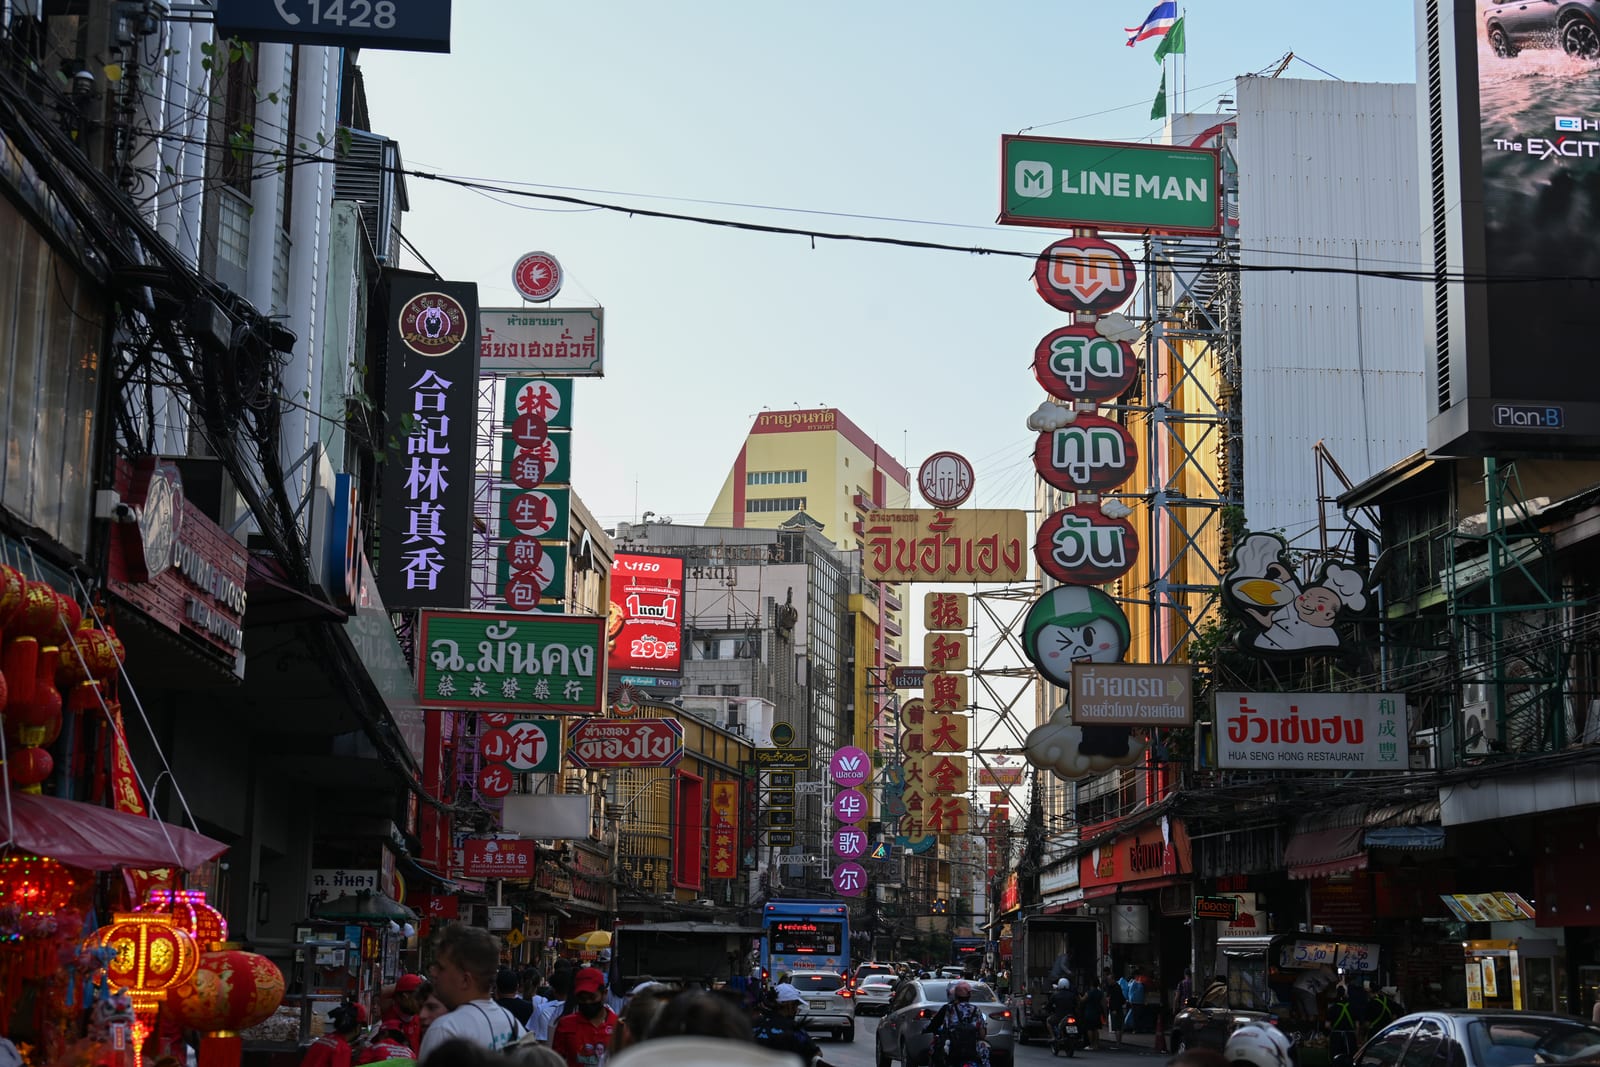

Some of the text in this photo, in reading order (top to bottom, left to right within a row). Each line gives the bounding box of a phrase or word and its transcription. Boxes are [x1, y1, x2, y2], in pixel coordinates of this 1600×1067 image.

[310, 0, 397, 30] 1428
[1493, 139, 1522, 152] The
[507, 314, 564, 327] ห้างขายยา
[1053, 338, 1122, 389] สุด
[1055, 431, 1122, 480] ทุก
[400, 369, 454, 590] 合記林真香
[511, 418, 541, 606] 上海生煎包
[631, 561, 660, 573] 1150
[1081, 669, 1164, 698] ที่จอดรถ
[927, 593, 965, 834] 振和興大金行
[1228, 751, 1365, 762] HUA SENG HONG RESTAURANT
[835, 770, 864, 779] Wacoal
[839, 795, 861, 891] 华歌尔
